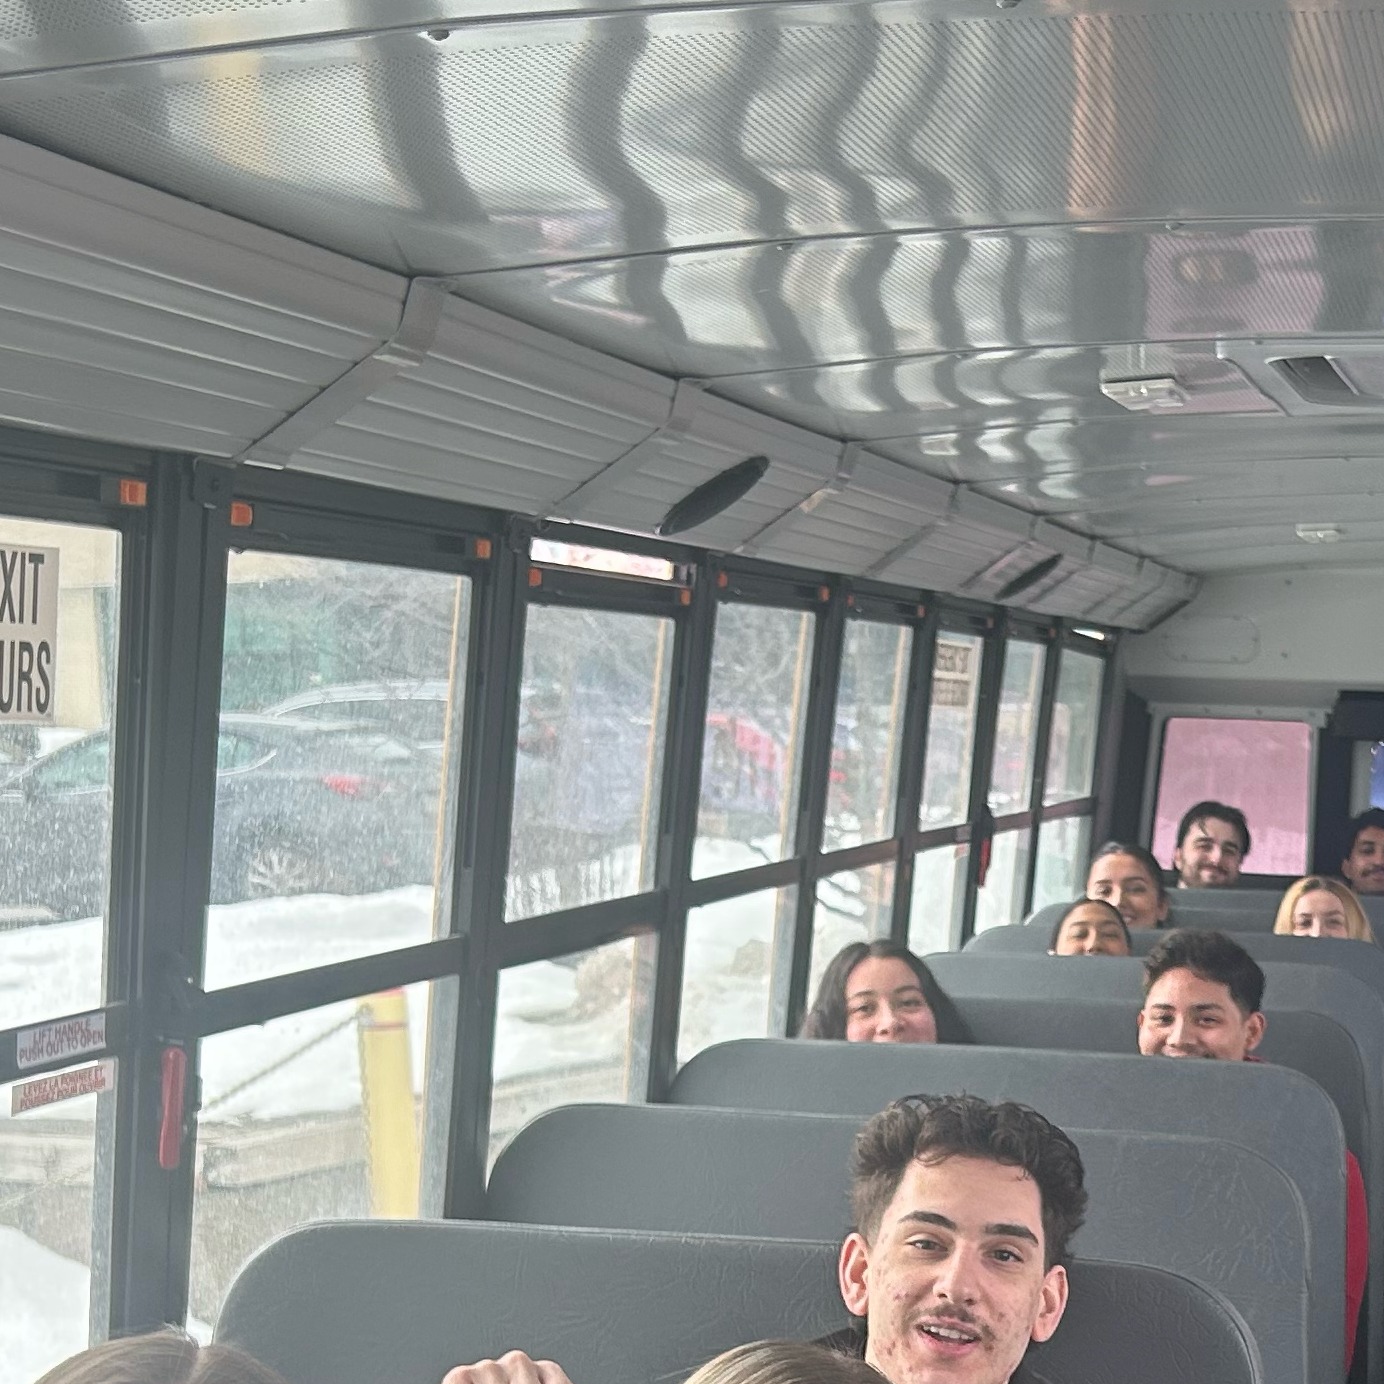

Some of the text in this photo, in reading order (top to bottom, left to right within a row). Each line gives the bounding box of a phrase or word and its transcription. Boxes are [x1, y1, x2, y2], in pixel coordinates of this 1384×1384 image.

[0, 550, 45, 625] XIT
[0, 639, 51, 714] URS
[20, 1029, 104, 1062] PUSH OUT TO OPEN
[33, 1018, 90, 1044] LIFT HANDLE
